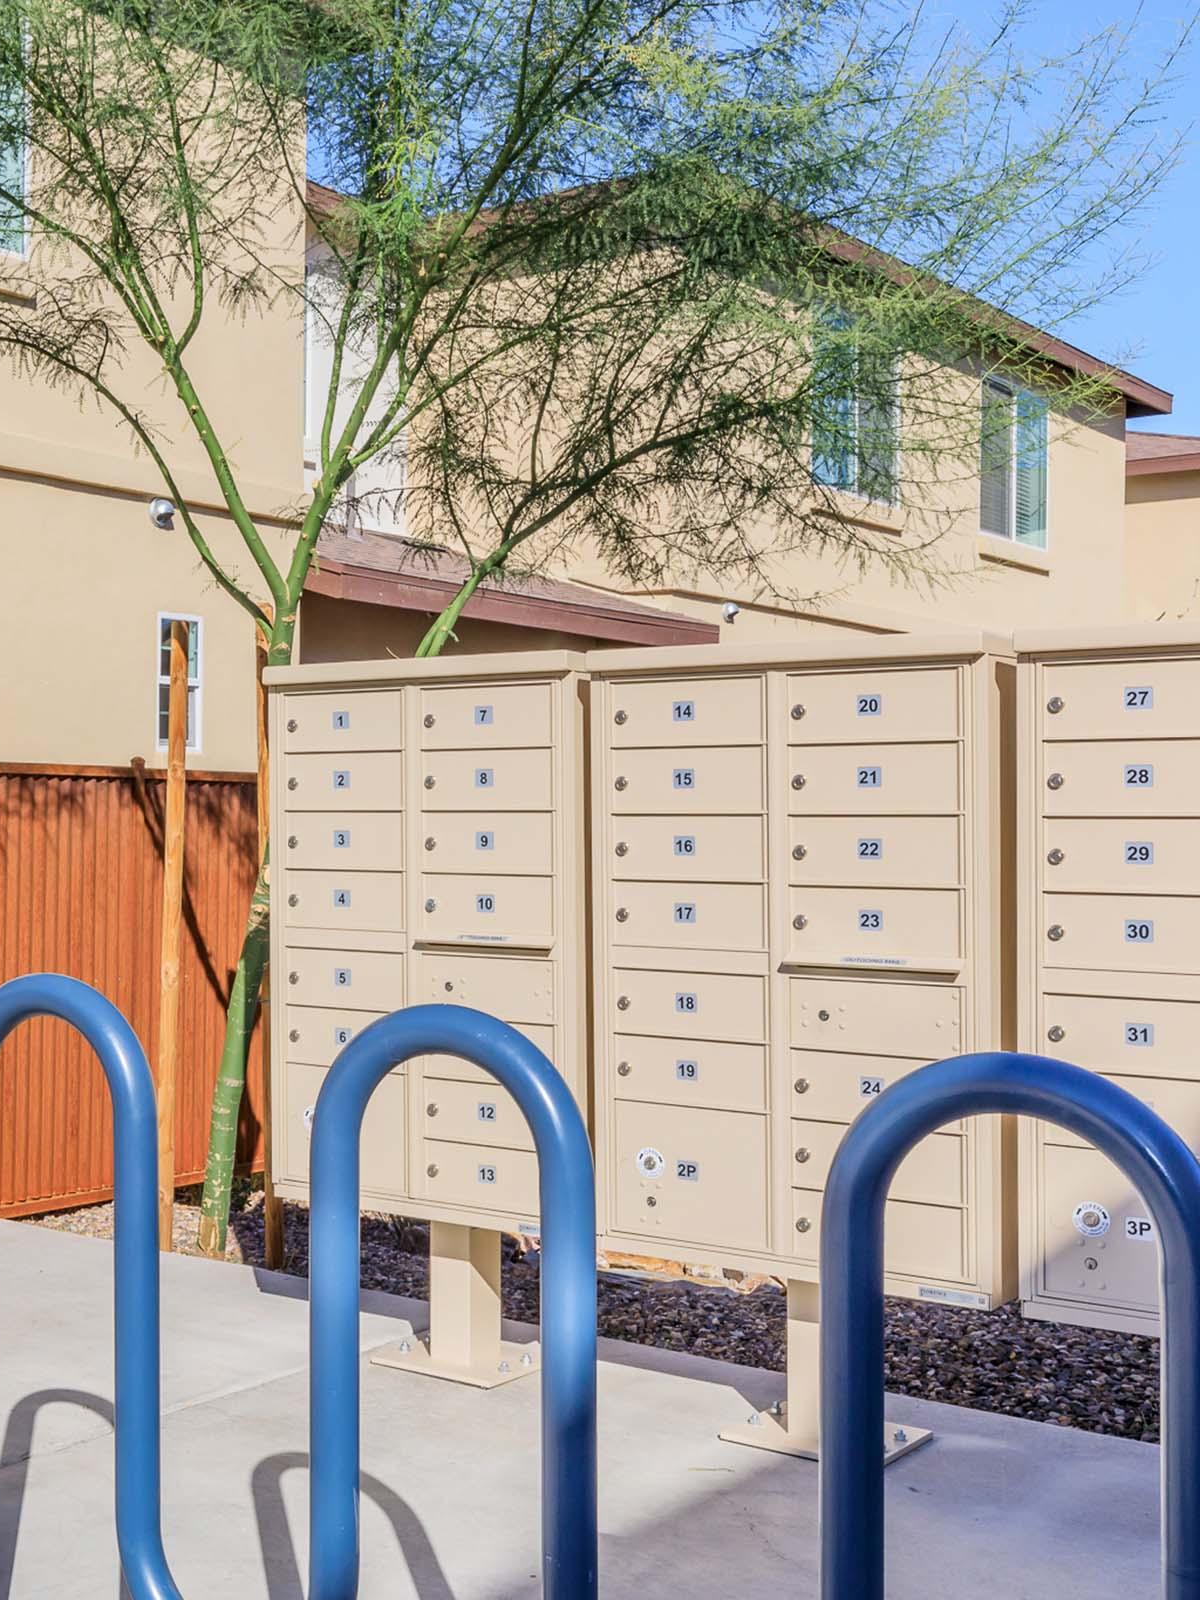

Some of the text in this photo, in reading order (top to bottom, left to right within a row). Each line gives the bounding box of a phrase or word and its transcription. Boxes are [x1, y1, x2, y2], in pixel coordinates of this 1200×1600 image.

[859, 698, 878, 713] 20
[1126, 691, 1149, 706] 27
[479, 709, 487, 722] 7
[674, 704, 692, 718] 14
[337, 715, 343, 727] 1
[337, 774, 345, 786] 2
[479, 772, 488, 785] 8
[675, 772, 692, 786] 15
[859, 770, 876, 784] 21
[1127, 769, 1149, 784] 28
[338, 833, 345, 846] 3
[480, 835, 489, 848] 9
[675, 839, 693, 853] 16
[859, 842, 879, 856] 22
[1127, 846, 1150, 861] 29
[338, 893, 345, 905] 4
[478, 897, 493, 910] 10
[676, 906, 693, 920] 17
[860, 913, 880, 928] 23
[1127, 924, 1150, 940] 30
[339, 972, 346, 984] 5
[677, 996, 695, 1010] 18
[339, 1031, 347, 1044] 6
[1127, 1027, 1148, 1043] 31
[678, 1063, 695, 1078] 19
[862, 1080, 881, 1095] 24
[479, 1106, 494, 1119] 12
[479, 1168, 495, 1182] 13
[677, 1163, 697, 1177] 2P
[1127, 1220, 1152, 1236] 3P
